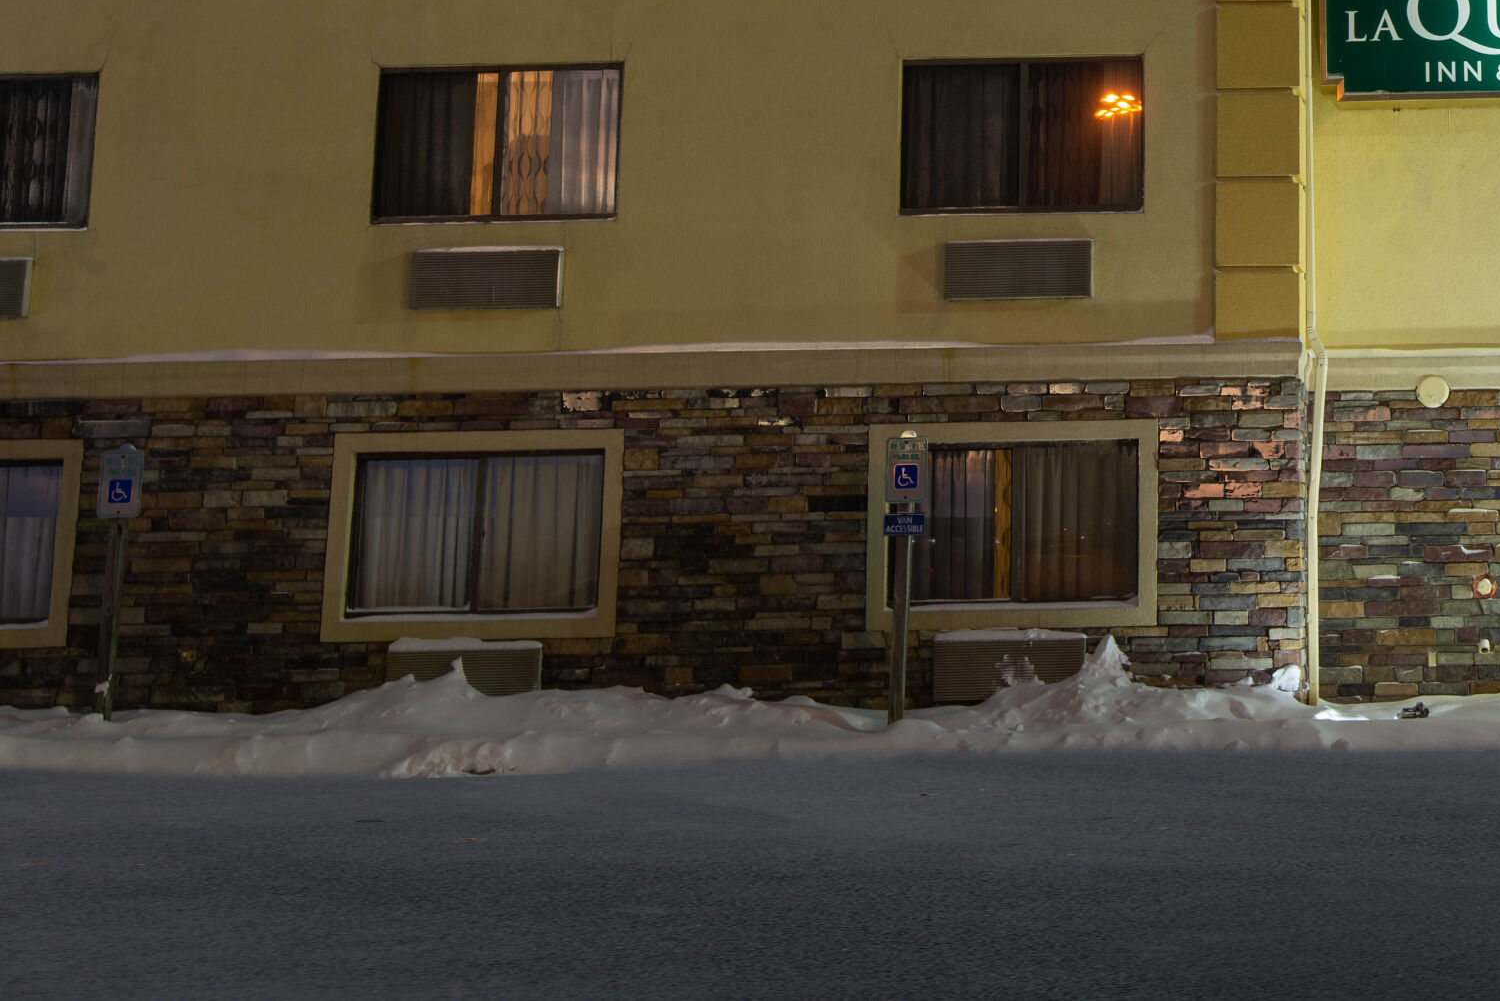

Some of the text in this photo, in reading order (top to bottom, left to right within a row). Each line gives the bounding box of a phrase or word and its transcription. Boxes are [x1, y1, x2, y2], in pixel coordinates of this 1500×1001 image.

[1345, 9, 1403, 43] LA
[1425, 61, 1482, 83] INN
[897, 516, 913, 524] VAN
[885, 524, 924, 533] ACCESSIBLE
